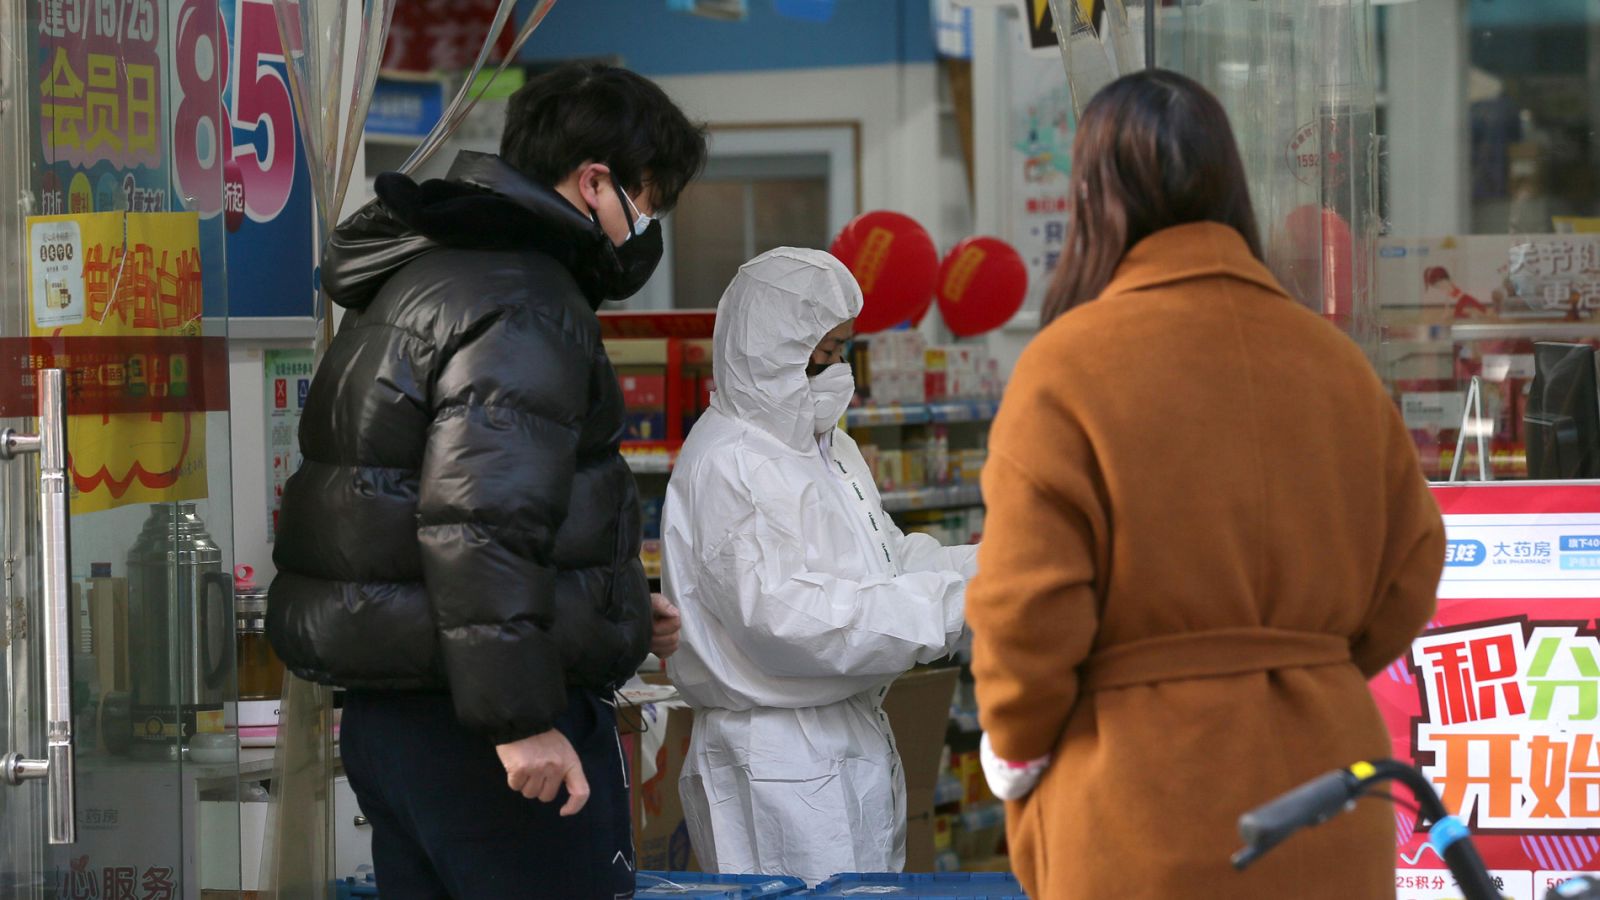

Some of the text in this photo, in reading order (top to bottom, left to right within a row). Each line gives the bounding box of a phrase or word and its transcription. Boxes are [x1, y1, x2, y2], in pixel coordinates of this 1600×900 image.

[40, 46, 157, 155] 会员日
[1493, 541, 1551, 557] 大药房
[1423, 634, 1600, 726] 积分
[1429, 734, 1600, 818] 开始
